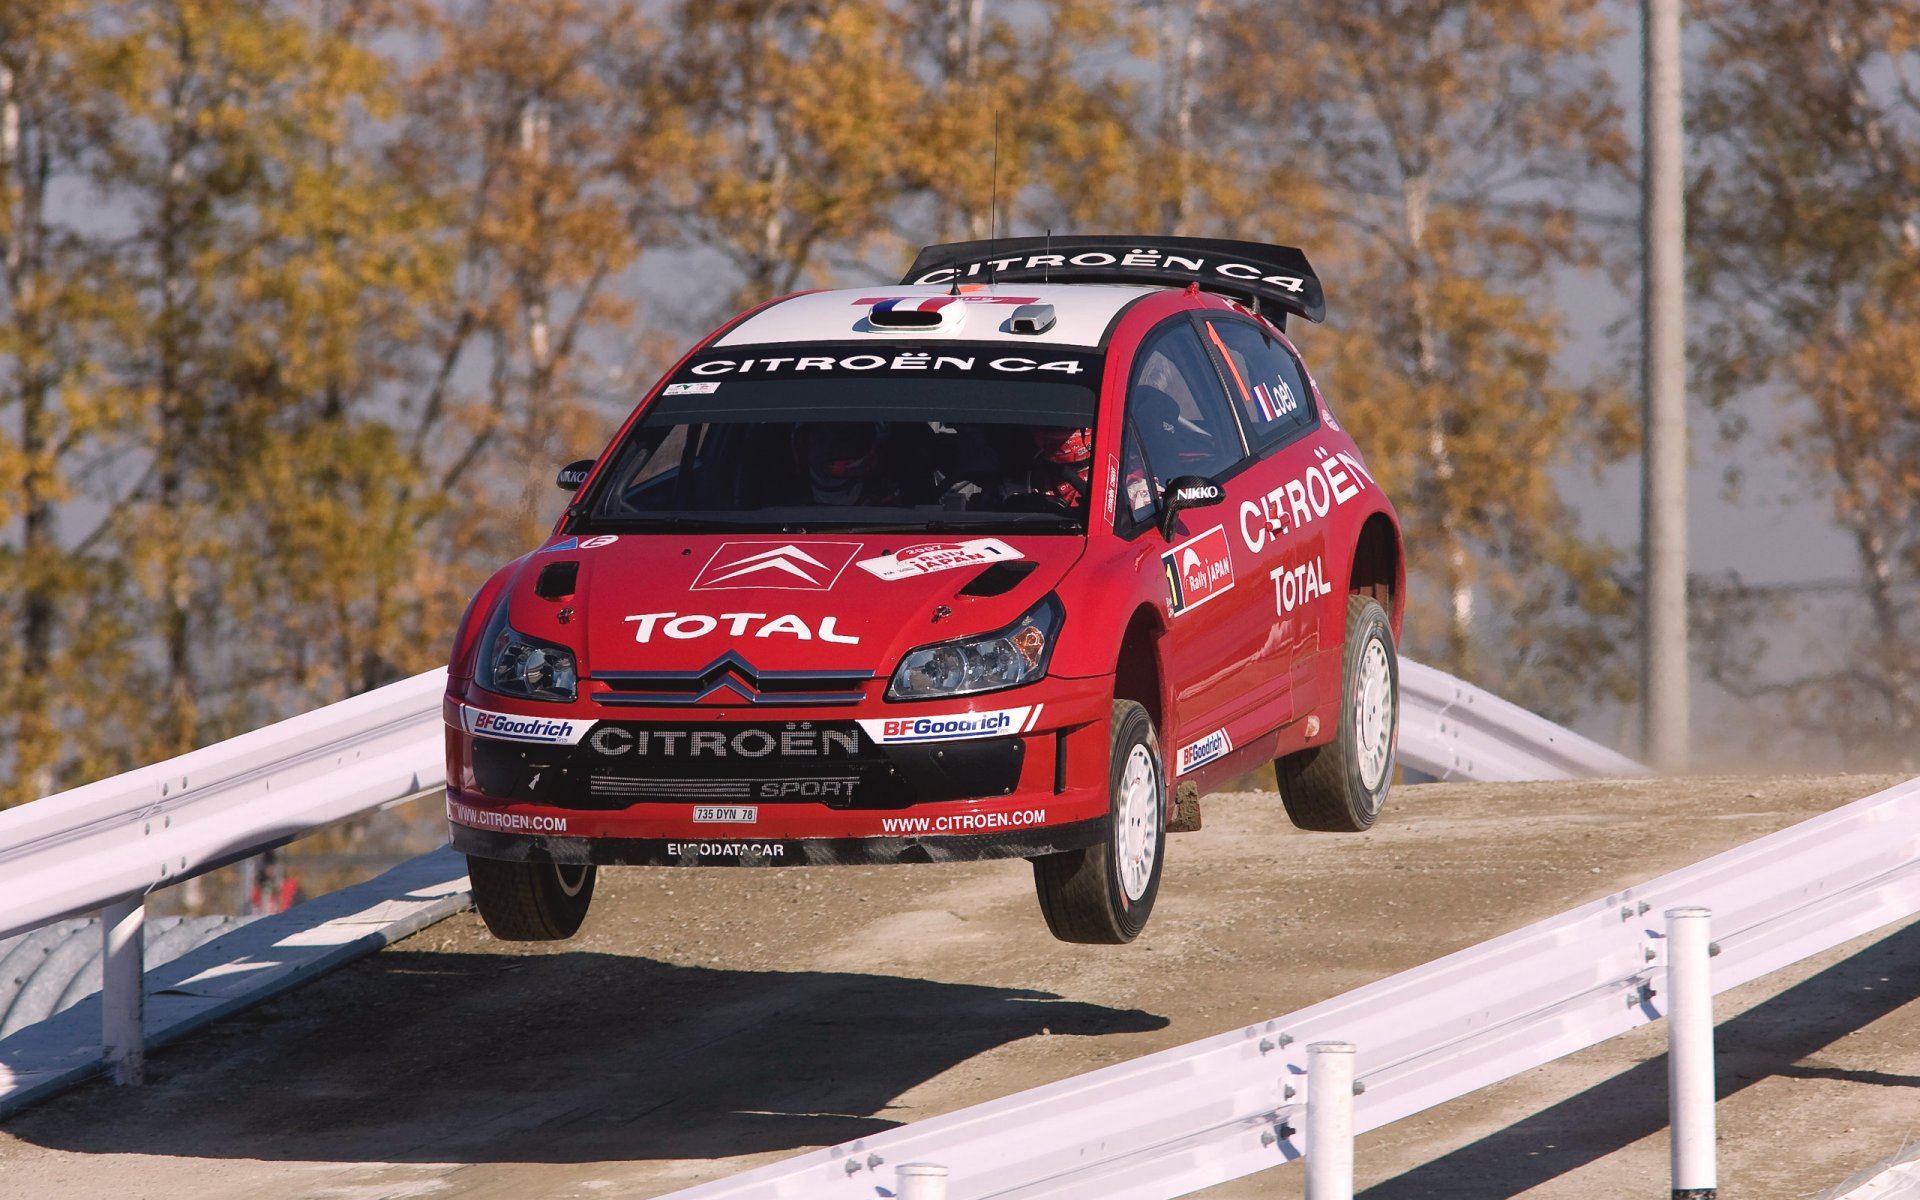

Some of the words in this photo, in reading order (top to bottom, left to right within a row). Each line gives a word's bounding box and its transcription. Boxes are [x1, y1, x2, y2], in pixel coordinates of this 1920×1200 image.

[914, 249, 1203, 285] CITROËN
[1216, 263, 1304, 293] C4
[691, 352, 976, 376] CITROËN
[989, 357, 1084, 375] C4
[1262, 373, 1298, 418] Loeb
[1177, 485, 1219, 501] NIKKO
[1240, 446, 1374, 553] CITROËN
[905, 544, 942, 555] 2007
[984, 547, 1001, 555] 1
[1166, 563, 1178, 607] 1
[1189, 570, 1207, 592] Rally
[1270, 556, 1331, 617] TOTAL
[624, 612, 860, 644] TOTAL
[475, 712, 573, 737] BFGoodrich
[883, 711, 1010, 737] BFGoodrich
[590, 721, 859, 757] CITROËN
[1184, 733, 1223, 766] BFGoodrich
[760, 781, 860, 797] SPORT
[457, 806, 567, 832] WWW.CITROEN.COM
[697, 808, 713, 820] 735
[716, 809, 737, 820] DYN
[742, 810, 753, 820] 78
[882, 809, 1046, 832] WWW.CITROEN.COM
